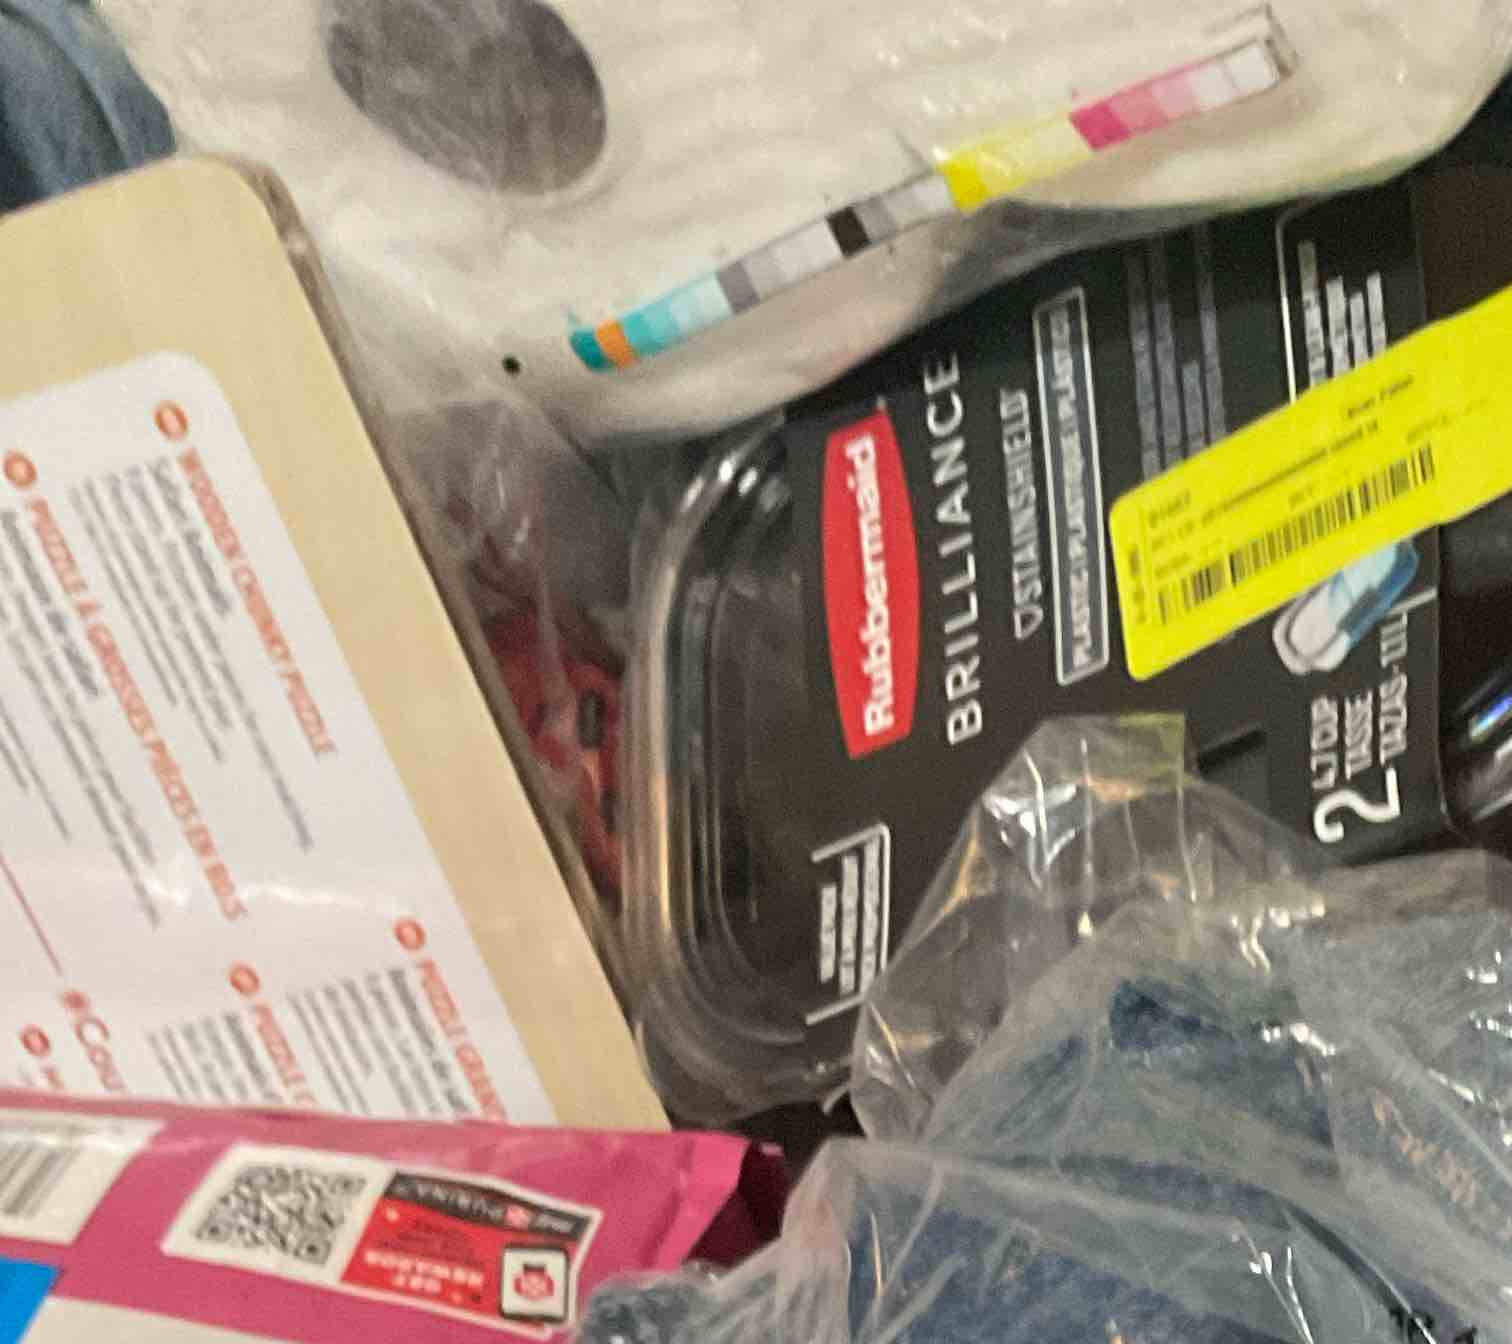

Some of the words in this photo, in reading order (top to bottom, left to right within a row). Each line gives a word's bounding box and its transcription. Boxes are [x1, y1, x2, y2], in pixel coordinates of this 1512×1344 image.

[846, 434, 894, 735] Rubbermaid
[924, 352, 982, 744] BRILLIANCE
[1312, 768, 1401, 842] 2
